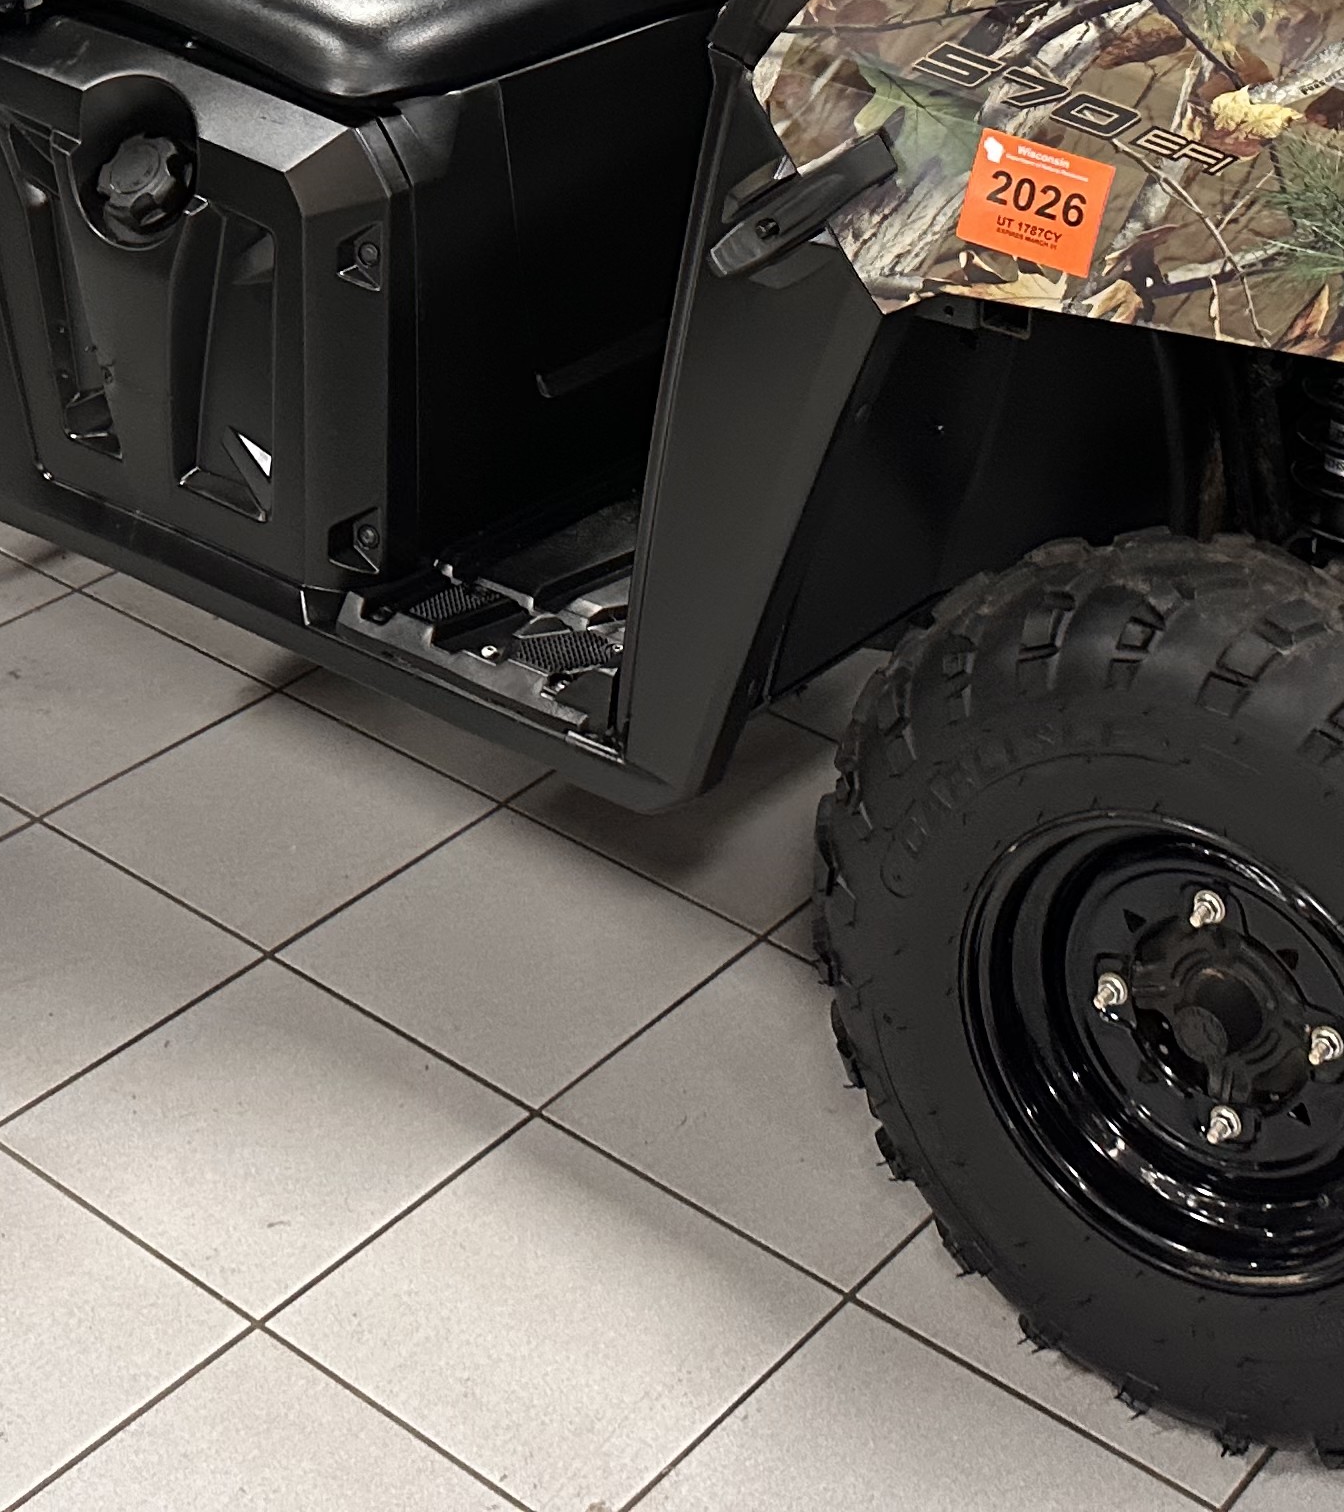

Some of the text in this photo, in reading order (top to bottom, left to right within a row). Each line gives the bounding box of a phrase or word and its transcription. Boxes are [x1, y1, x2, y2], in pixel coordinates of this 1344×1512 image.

[912, 41, 1240, 176] 570 EFI
[1017, 145, 1071, 169] Wisconsin
[986, 170, 1087, 227] 2026
[996, 215, 1063, 244] UT 1787CY
